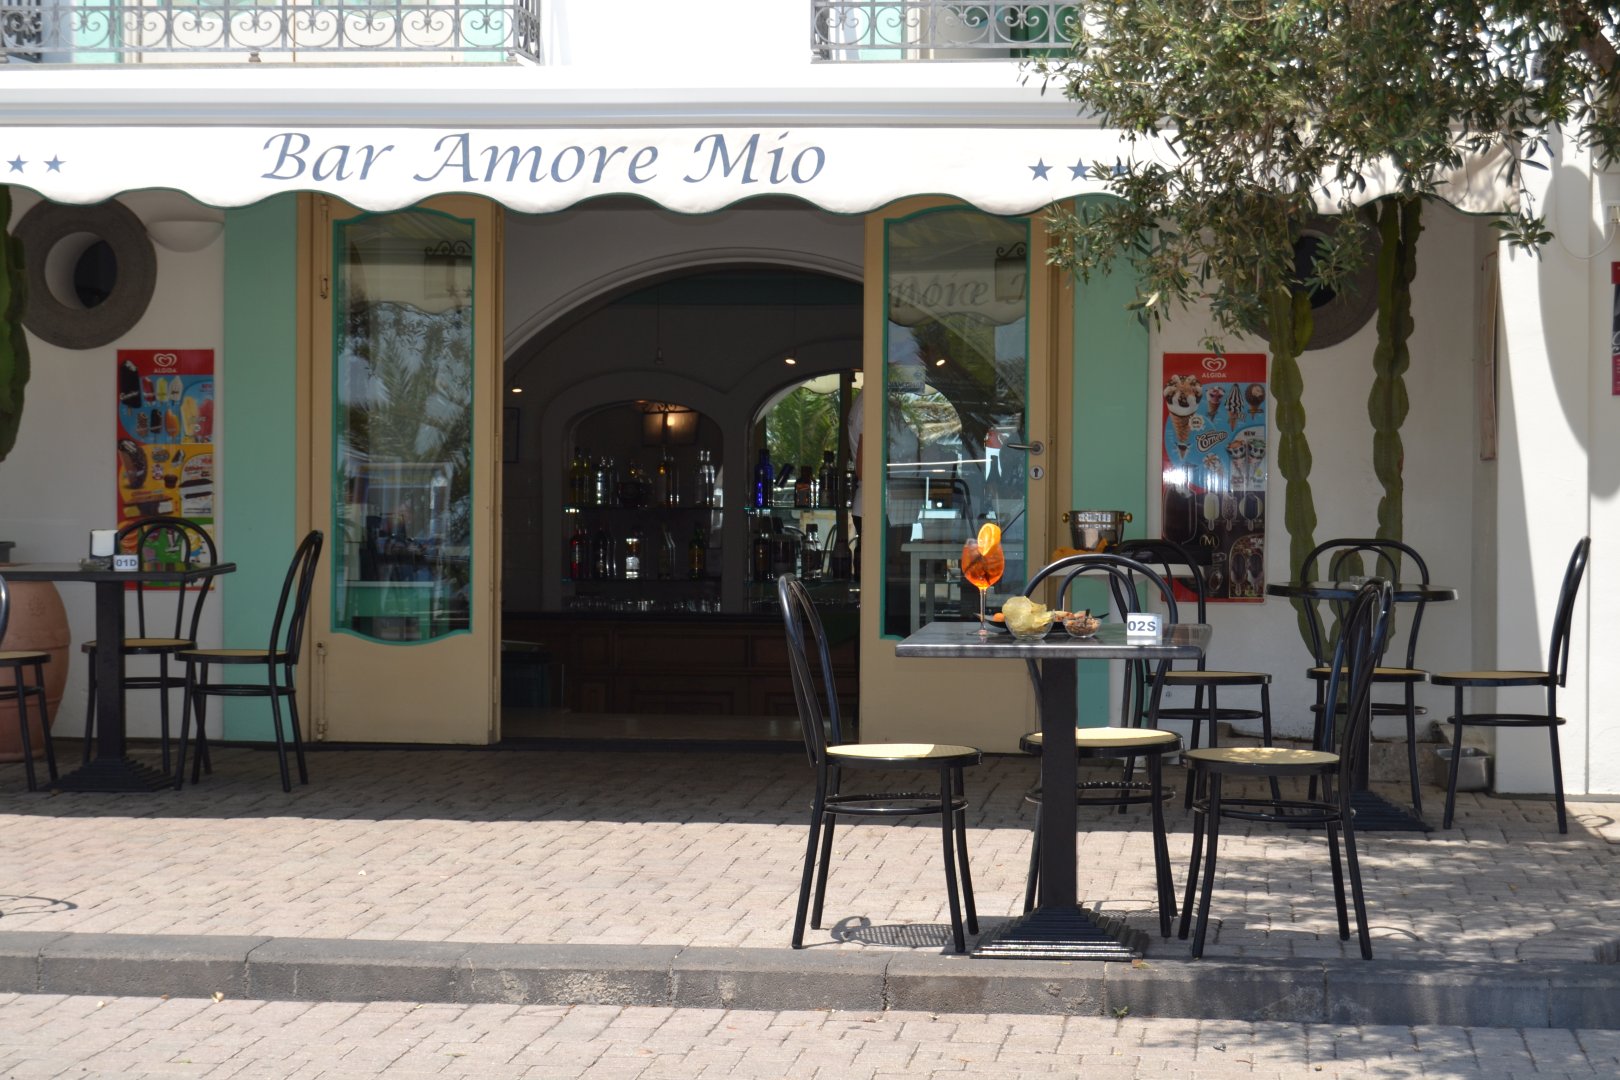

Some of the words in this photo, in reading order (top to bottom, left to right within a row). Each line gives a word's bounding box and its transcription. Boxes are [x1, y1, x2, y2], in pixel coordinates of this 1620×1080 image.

[260, 131, 395, 183] Bar
[412, 131, 659, 185] Amore
[1127, 620, 1156, 632] 02S
